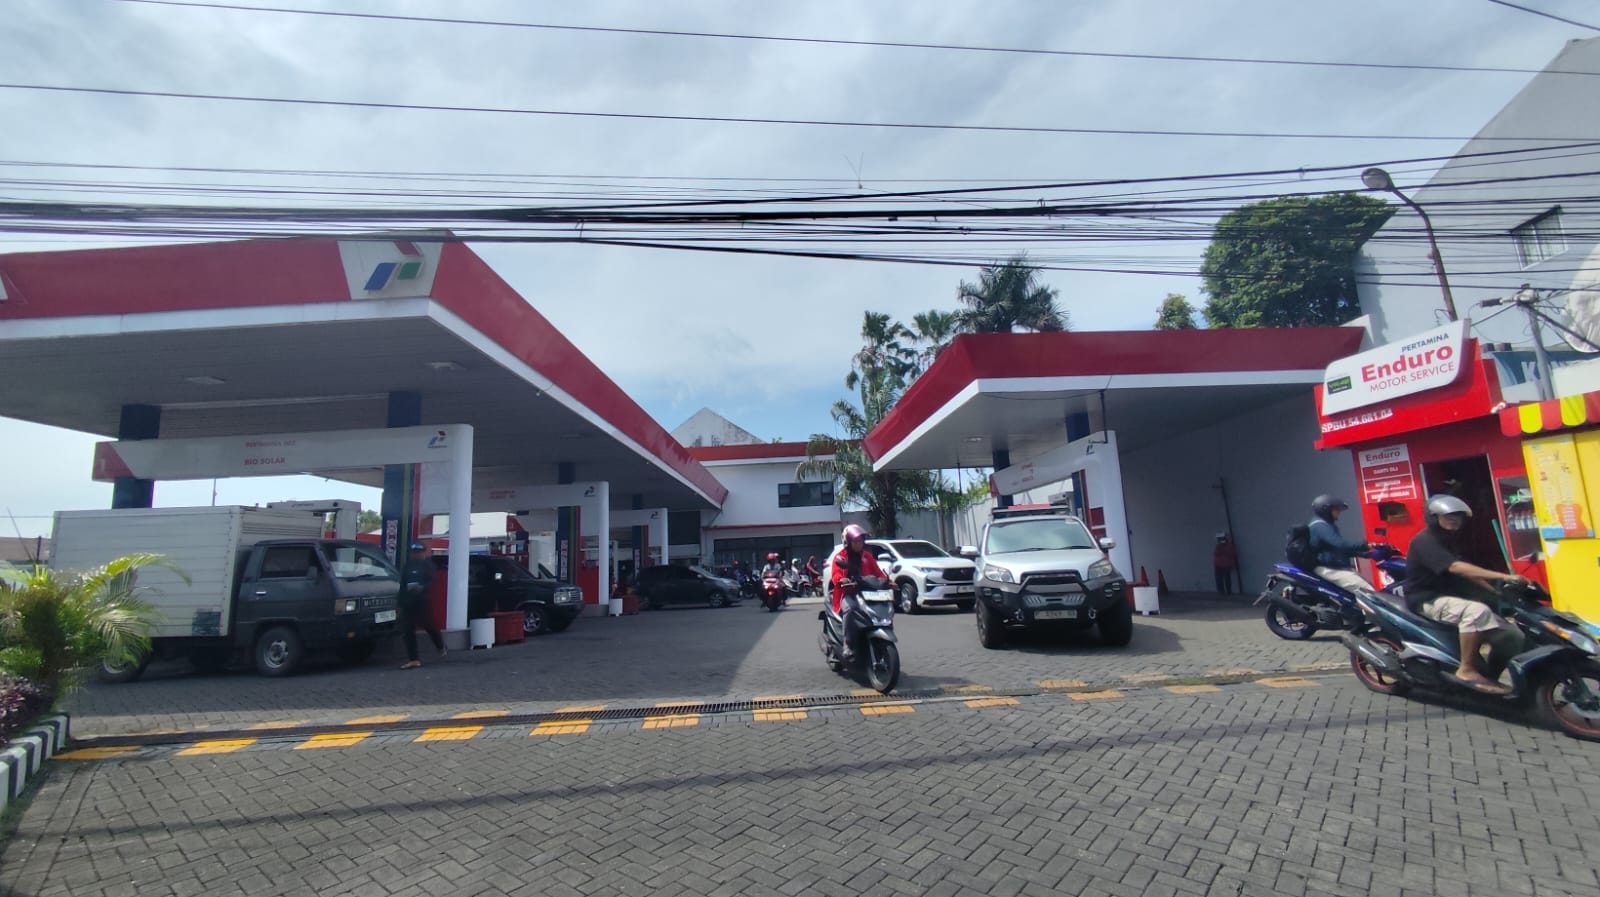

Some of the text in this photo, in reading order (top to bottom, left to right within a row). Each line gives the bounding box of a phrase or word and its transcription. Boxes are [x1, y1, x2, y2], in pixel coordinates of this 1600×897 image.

[1401, 332, 1450, 353] PERTAMINA
[1361, 345, 1454, 382] Enduro
[1370, 375, 1408, 393] MOTOR
[1410, 362, 1455, 382] SERVICE
[1321, 419, 1347, 433] SPBU
[244, 457, 286, 466] BIO SOLAR
[1365, 450, 1401, 462] Enduro
